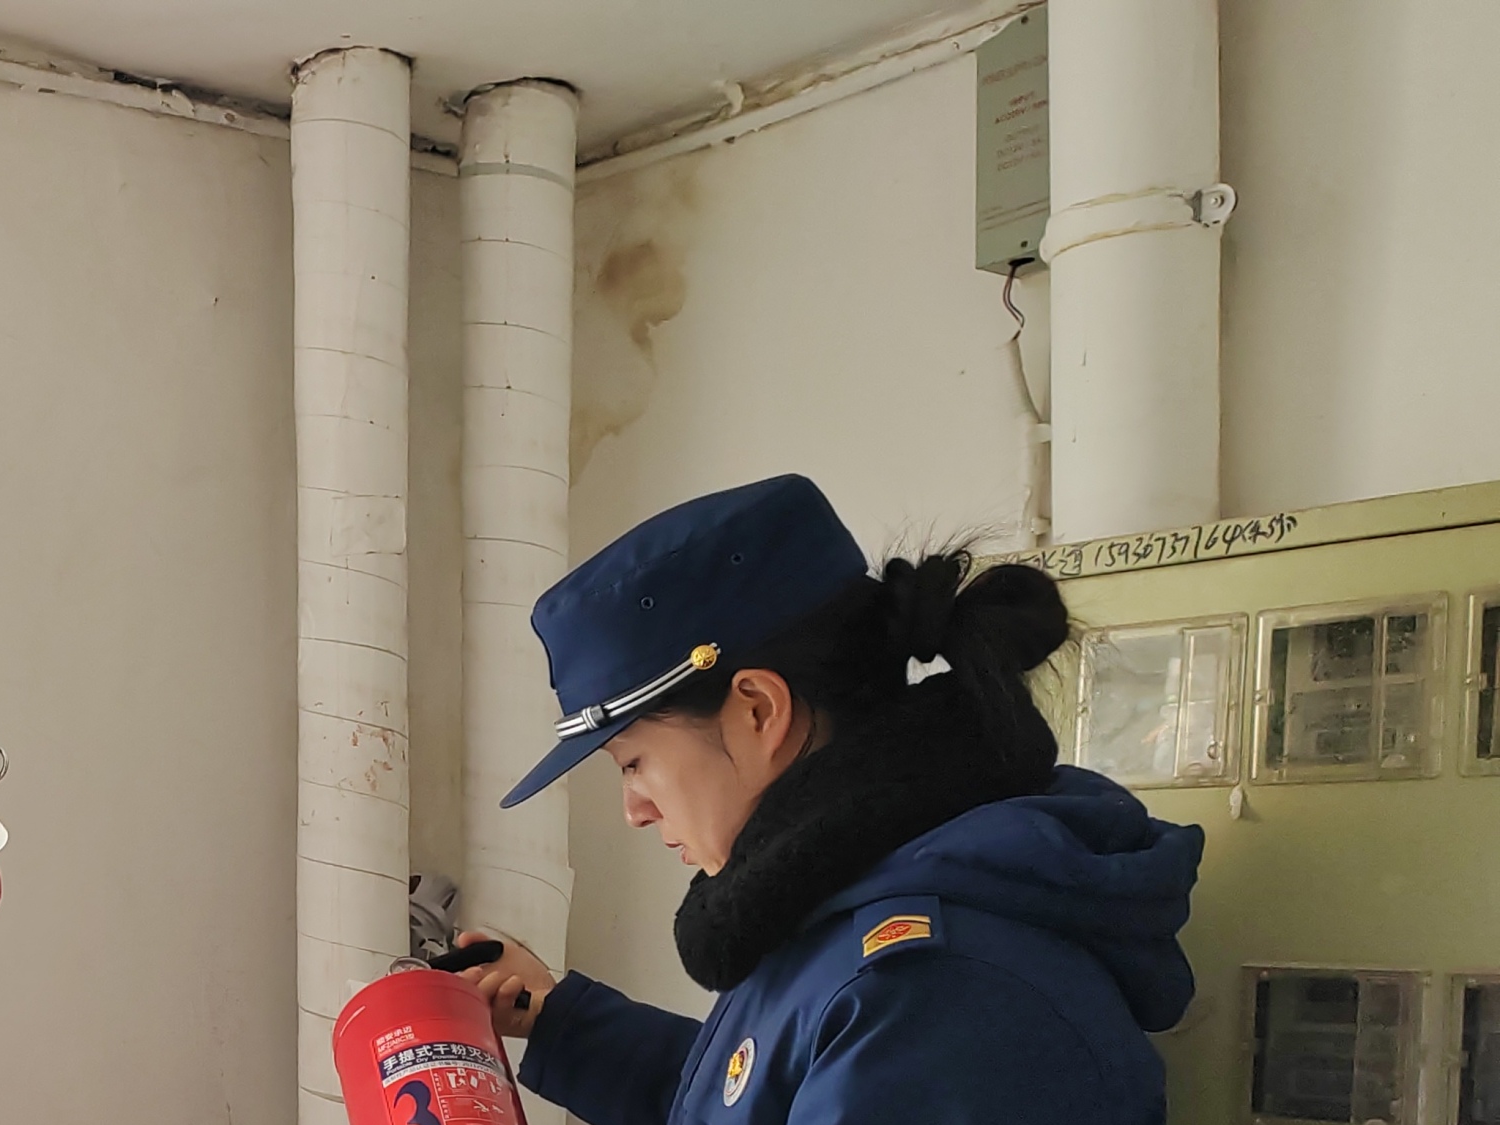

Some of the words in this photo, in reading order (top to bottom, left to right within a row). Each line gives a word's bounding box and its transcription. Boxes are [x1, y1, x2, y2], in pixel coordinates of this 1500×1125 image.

[383, 1042, 506, 1071] 手提式干粉灭火
